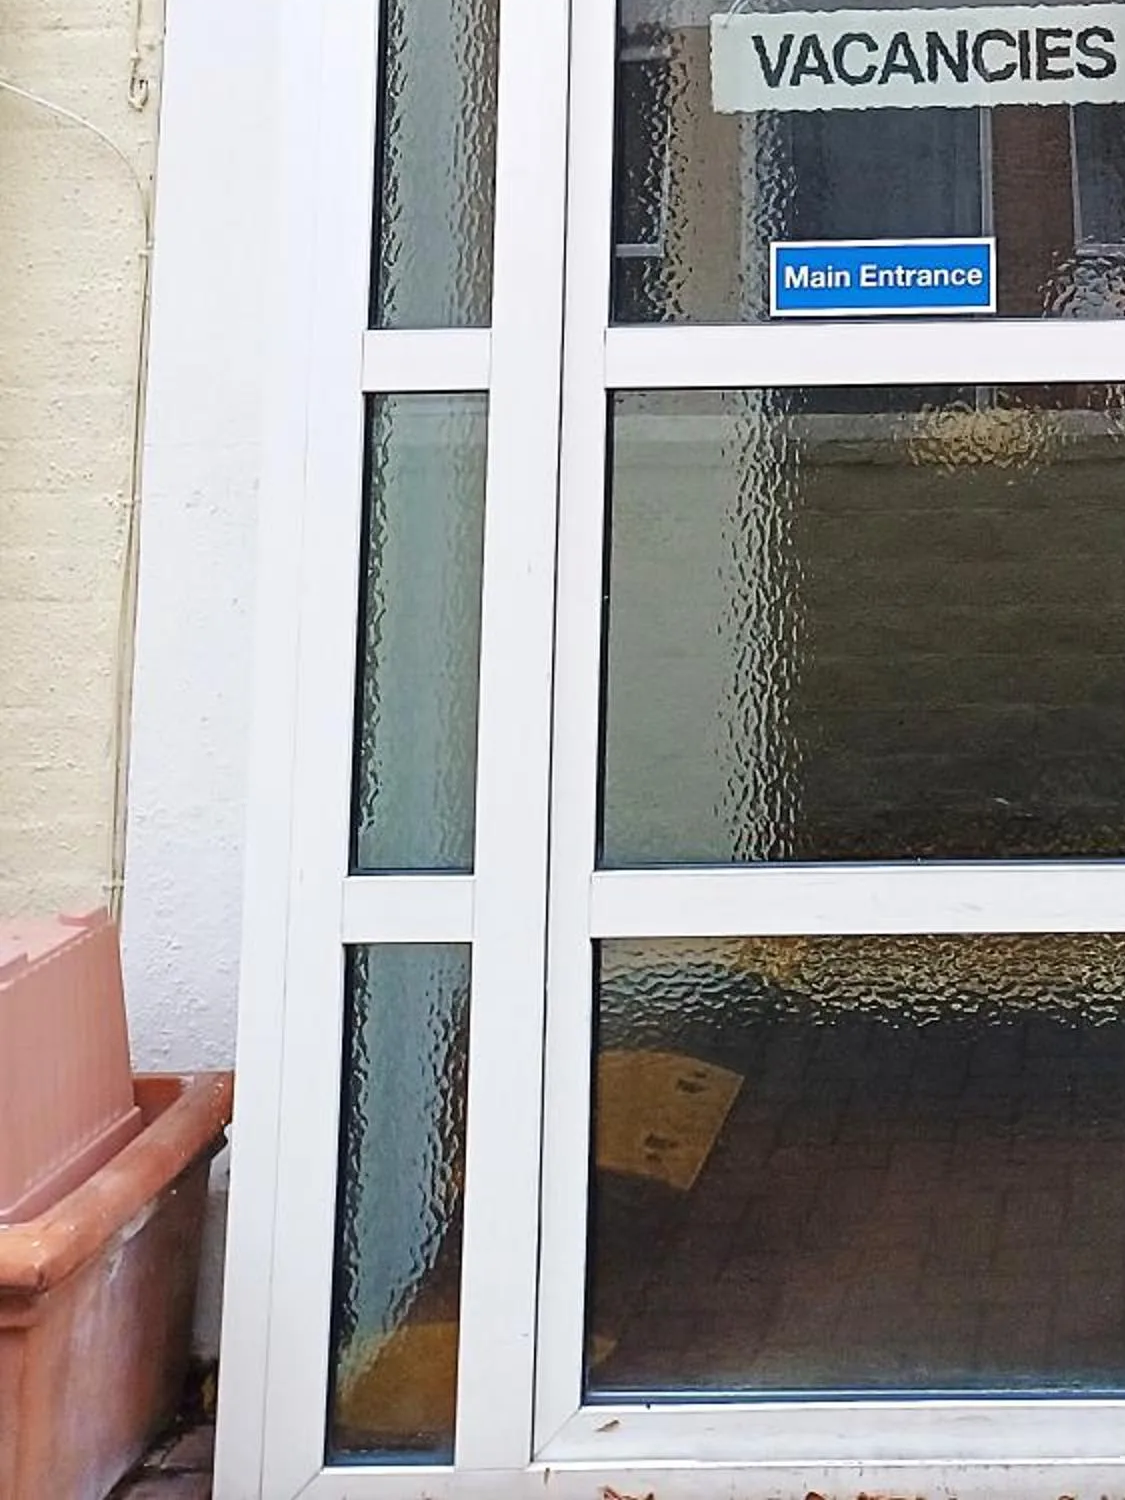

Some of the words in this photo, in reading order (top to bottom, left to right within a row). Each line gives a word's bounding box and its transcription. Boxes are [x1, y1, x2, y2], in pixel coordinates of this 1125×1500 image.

[751, 26, 1117, 88] VACANCIES
[784, 265, 851, 289] Main
[860, 263, 983, 288] Entrance
